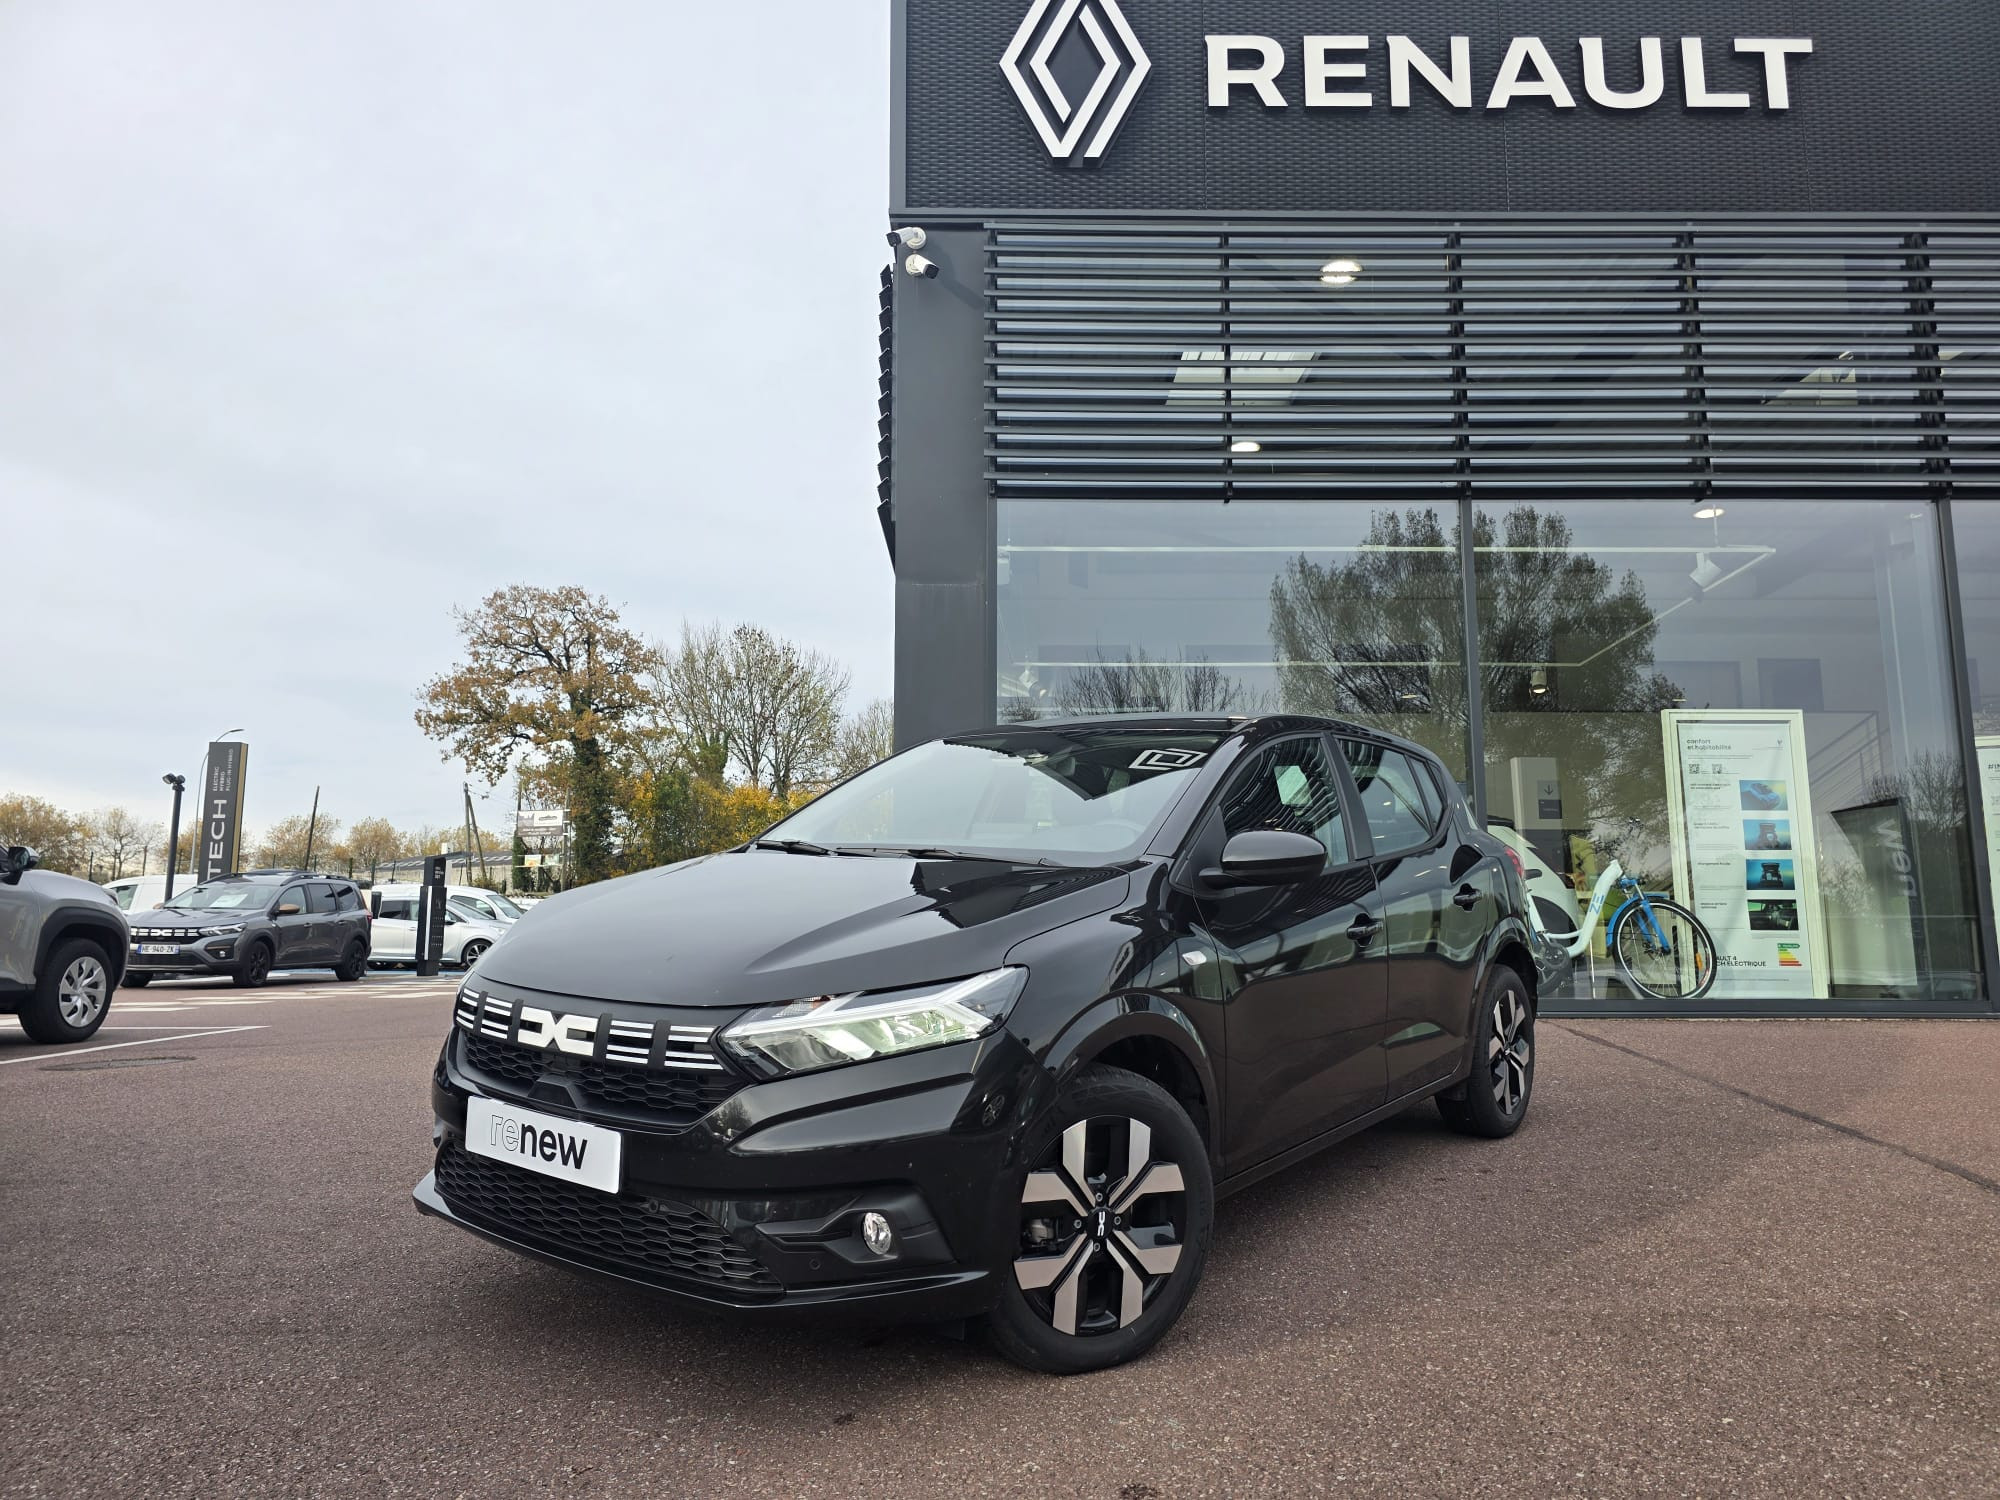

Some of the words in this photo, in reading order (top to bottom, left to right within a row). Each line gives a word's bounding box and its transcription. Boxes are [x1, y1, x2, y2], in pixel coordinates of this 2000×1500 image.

[1204, 33, 1814, 110] RENAULT
[207, 799, 228, 880] TECH
[490, 1113, 588, 1170] renew
